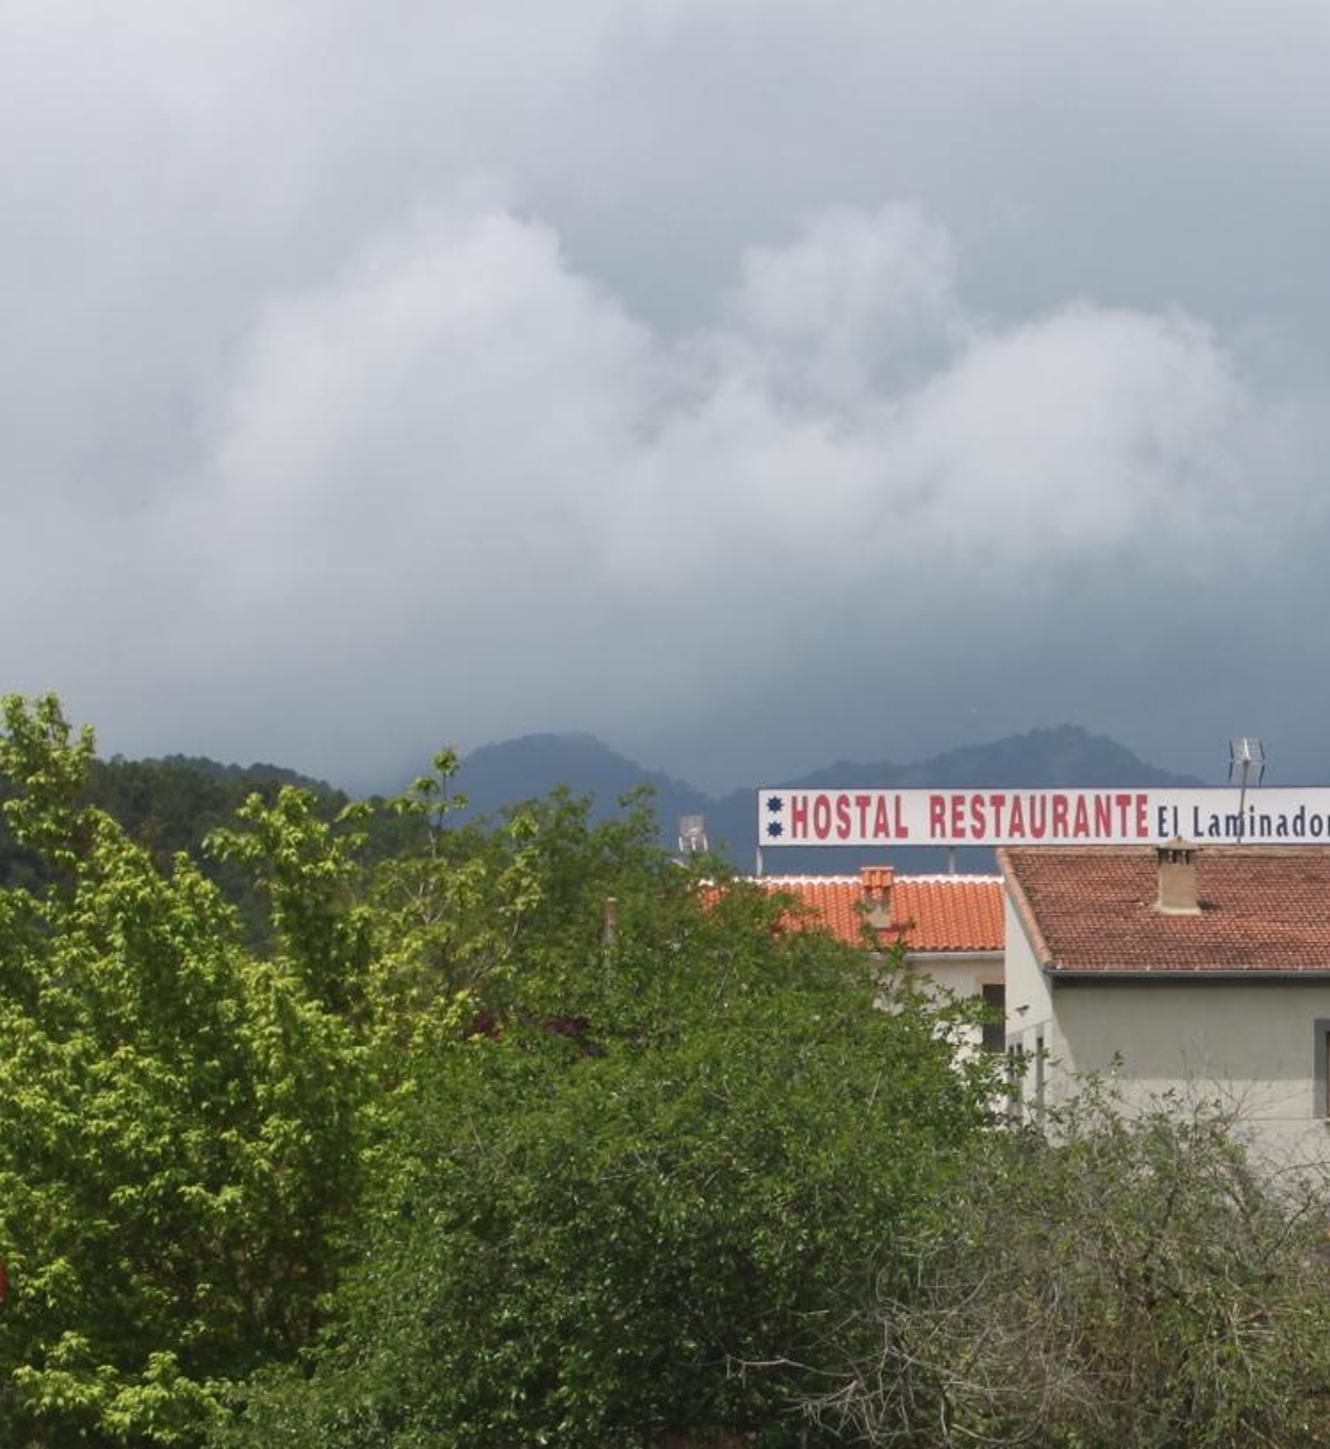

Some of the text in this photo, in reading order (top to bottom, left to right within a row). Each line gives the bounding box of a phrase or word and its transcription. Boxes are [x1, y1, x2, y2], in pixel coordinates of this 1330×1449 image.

[791, 794, 909, 840] HOSTAL
[929, 794, 1149, 840] RESTAURANTE
[1157, 806, 1179, 838] El
